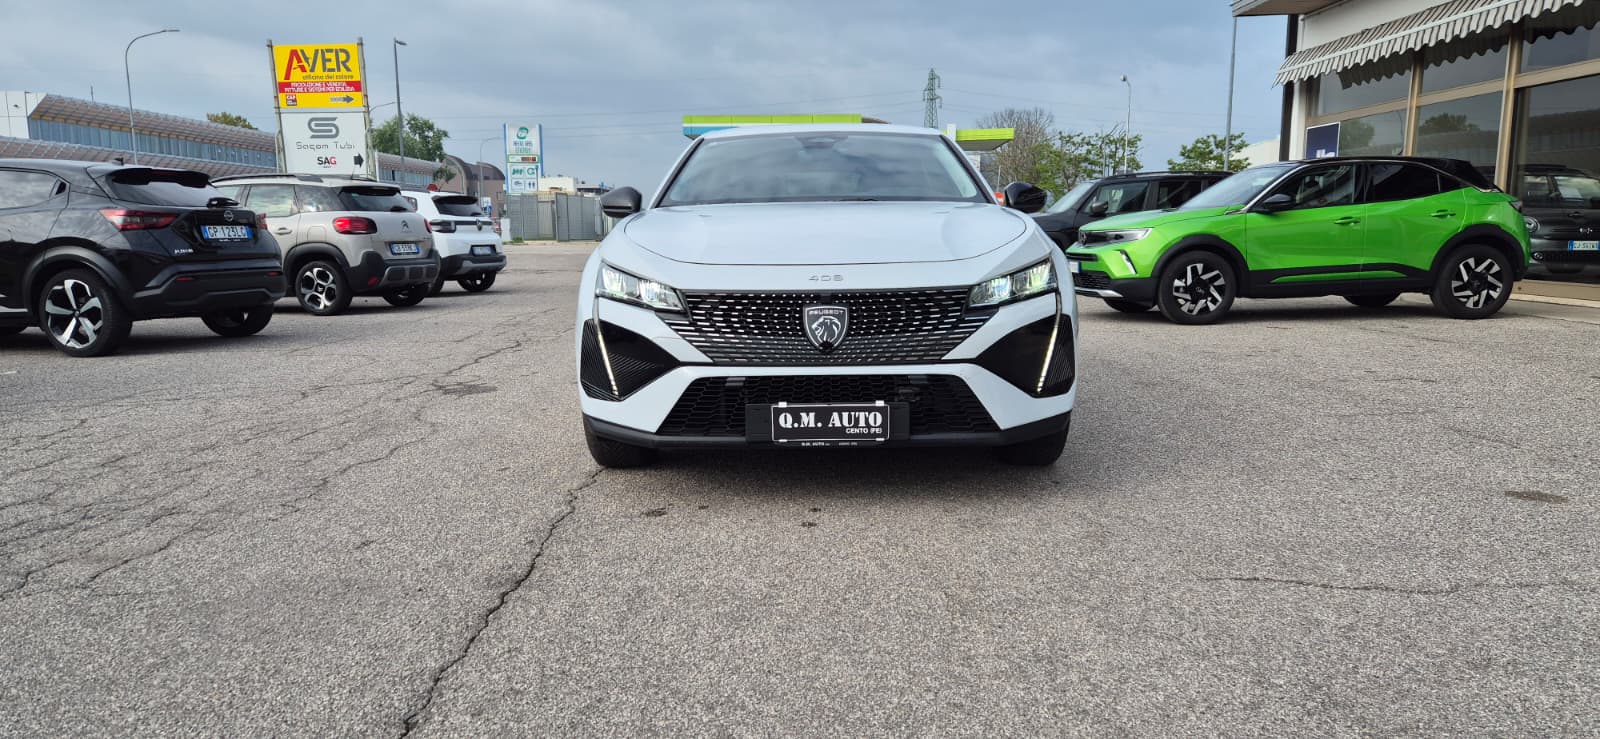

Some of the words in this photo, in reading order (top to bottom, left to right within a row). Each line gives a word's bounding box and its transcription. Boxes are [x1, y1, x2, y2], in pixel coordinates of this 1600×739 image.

[284, 48, 352, 80] AVER
[317, 156, 337, 165] SAG
[778, 412, 823, 428] Q.M.
[828, 411, 883, 428] AUTO
